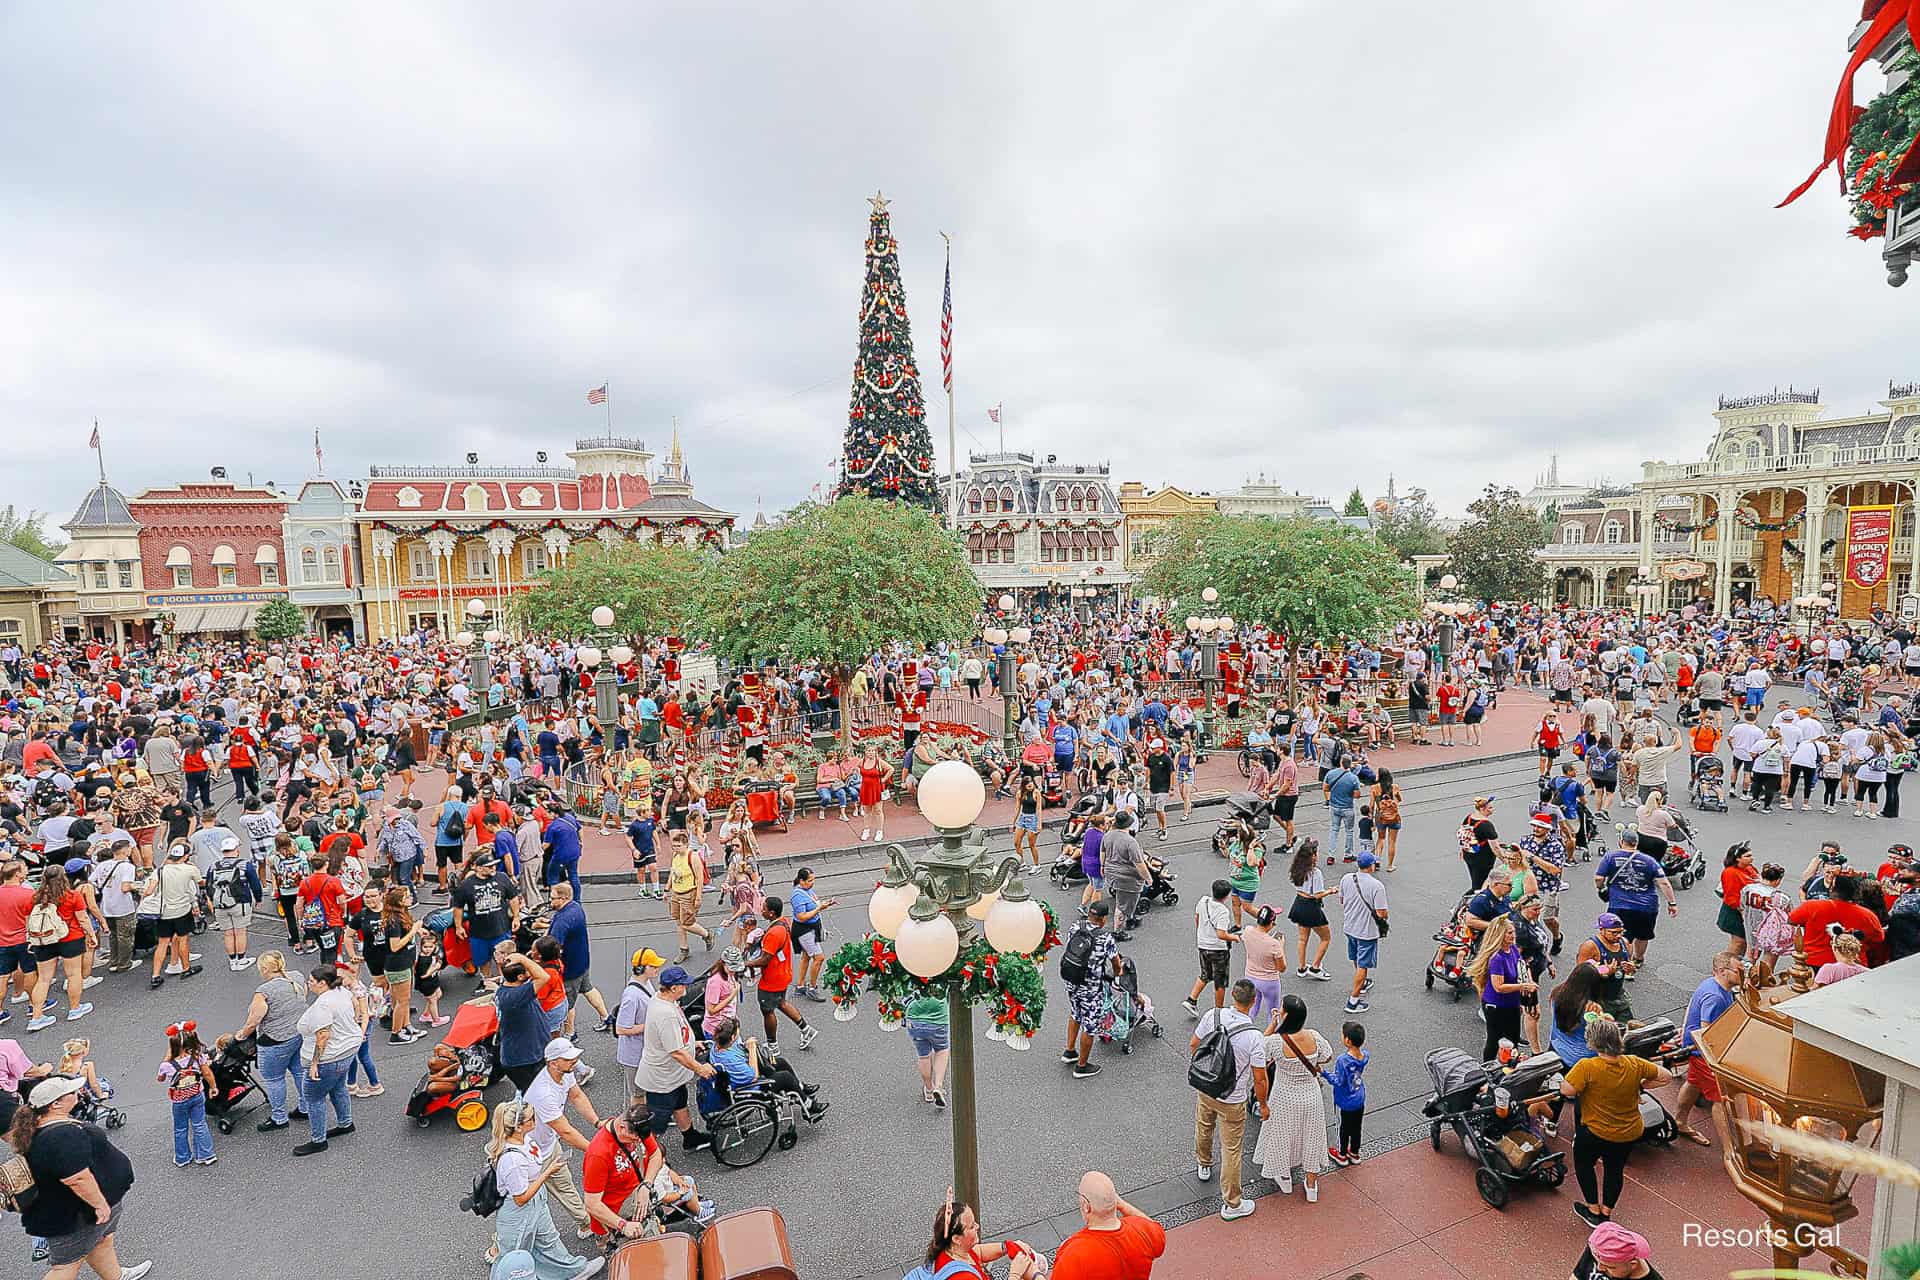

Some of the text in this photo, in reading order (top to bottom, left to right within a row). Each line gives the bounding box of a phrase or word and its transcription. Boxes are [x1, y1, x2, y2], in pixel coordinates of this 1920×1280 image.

[1850, 543, 1889, 555] MICKEY
[208, 593, 235, 602] TOYS
[246, 591, 281, 601] MUSIC
